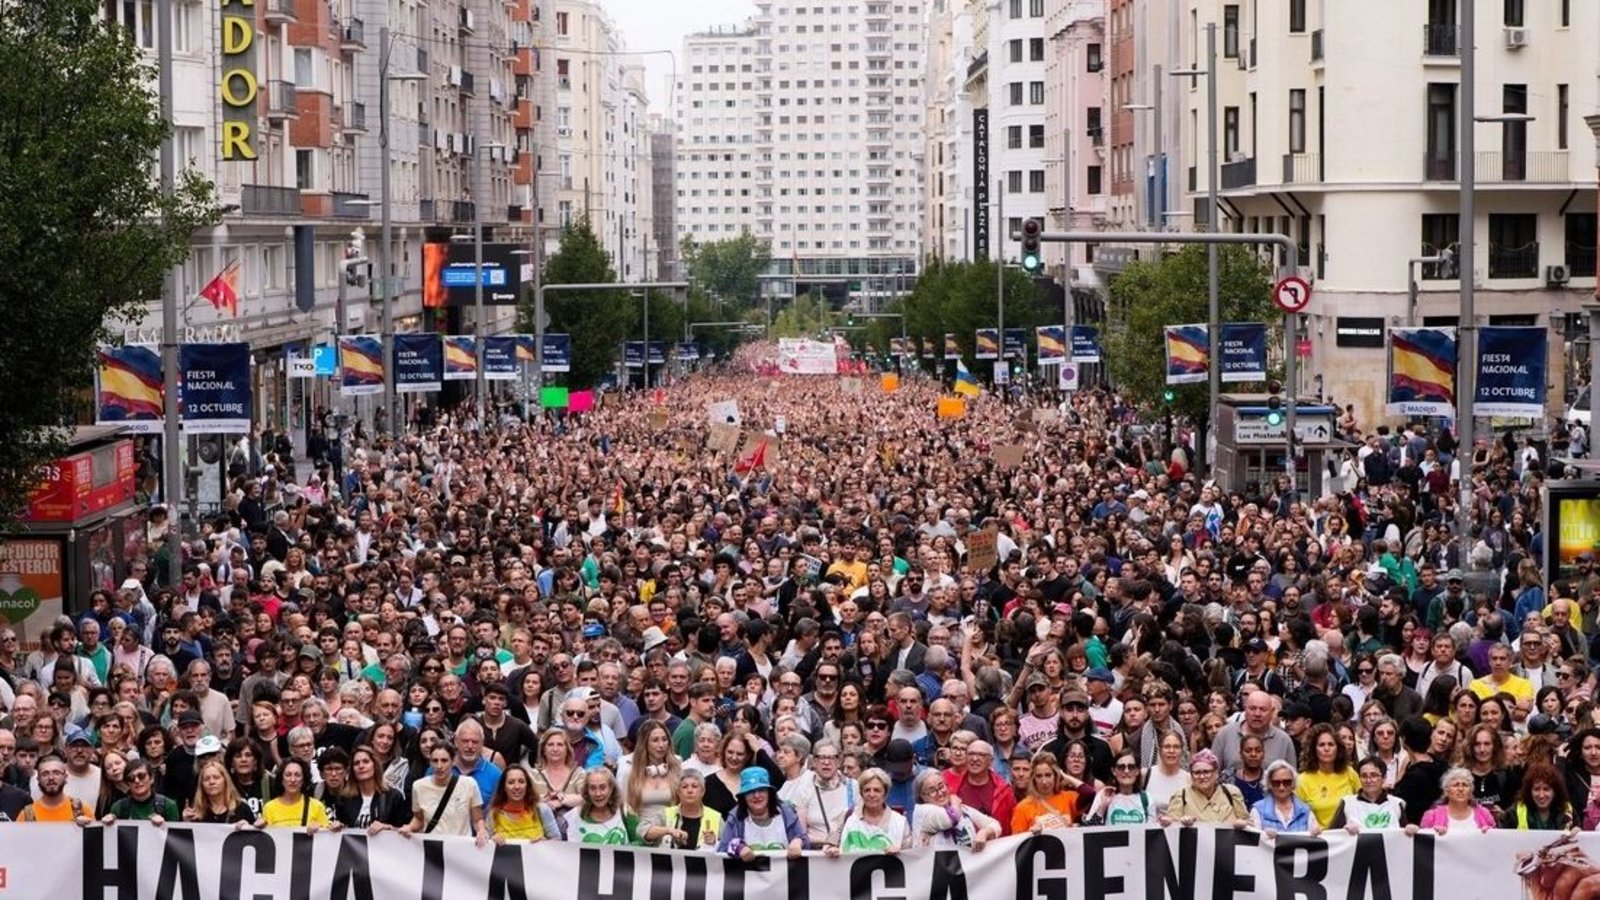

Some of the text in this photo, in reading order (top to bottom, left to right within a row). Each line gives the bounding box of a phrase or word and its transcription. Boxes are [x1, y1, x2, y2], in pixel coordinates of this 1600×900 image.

[221, 0, 257, 159] DOR
[978, 114, 986, 187] CATALONIA
[978, 193, 986, 233] PLAZA
[1482, 354, 1511, 363] FIESTA
[187, 370, 216, 380] FIESTA
[1481, 365, 1529, 374] NACIONAL
[187, 381, 235, 390] NACIONAL
[1480, 388, 1536, 399] 12 OCTUBRE
[188, 403, 243, 414] 12 OCTUBRE
[1407, 405, 1437, 414] MADRID
[82, 825, 374, 900] HACIA
[1014, 827, 1436, 900] GENERAL
